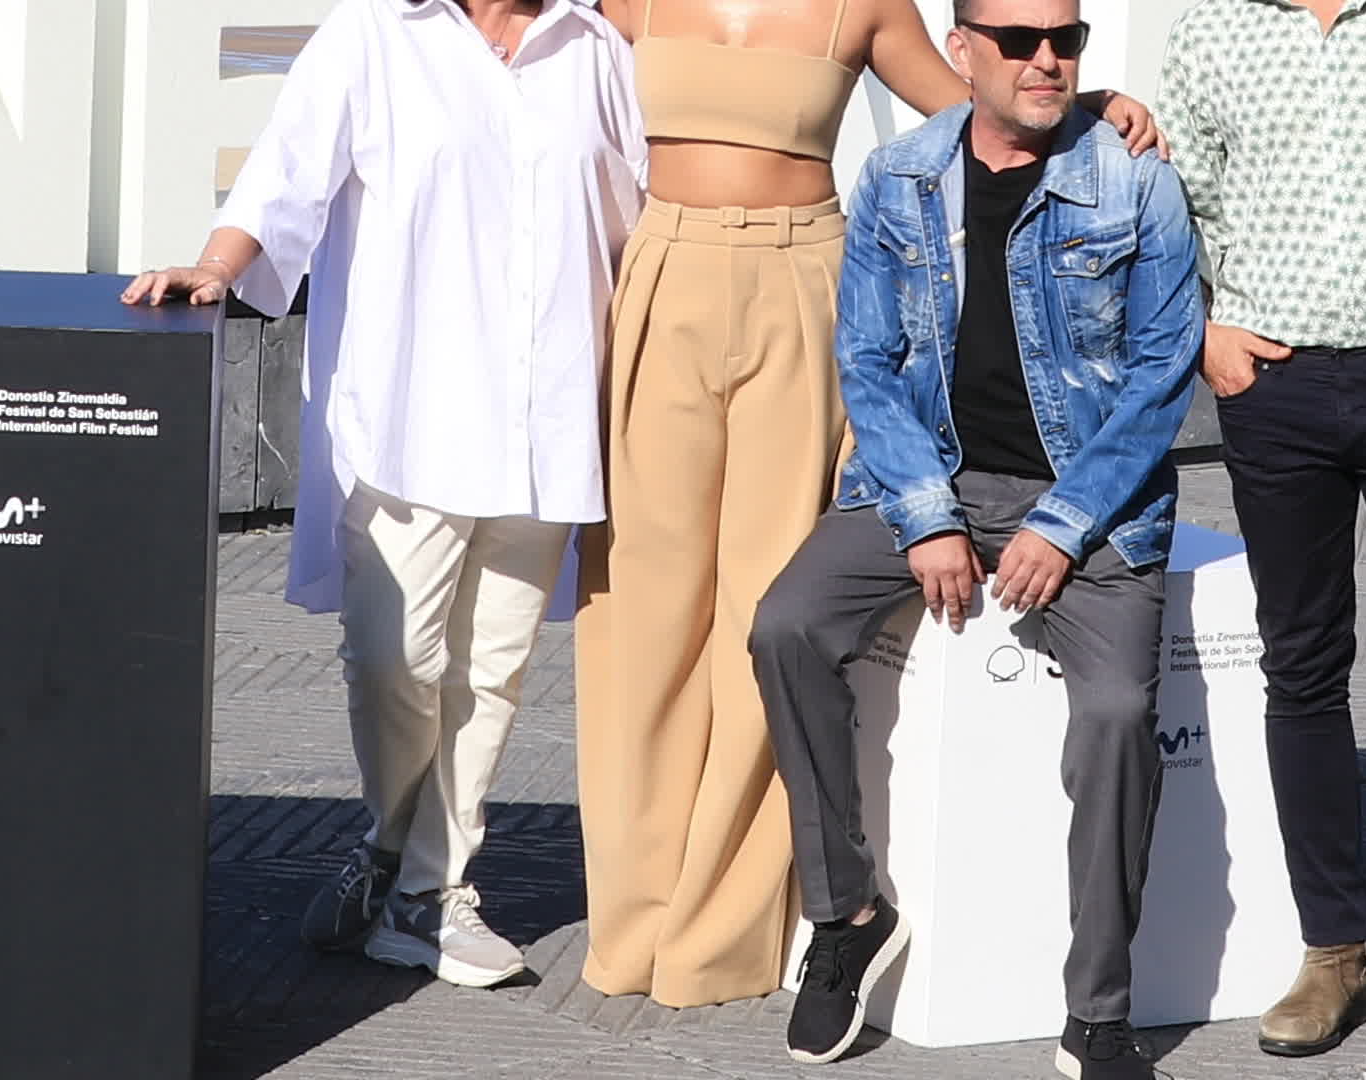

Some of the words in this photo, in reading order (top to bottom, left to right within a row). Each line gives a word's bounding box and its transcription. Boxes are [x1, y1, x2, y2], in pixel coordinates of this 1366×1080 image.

[57, 391, 127, 406] Zinemaldia
[48, 407, 65, 419] de
[68, 407, 93, 420] San
[95, 408, 159, 422] Sebastián
[79, 422, 107, 435] Film
[109, 424, 158, 437] Festival
[1171, 633, 1214, 645] Donostia
[1171, 648, 1207, 658] Festival
[1210, 647, 1222, 655] de
[1224, 646, 1242, 655] San
[1170, 660, 1230, 672] International
[1232, 658, 1253, 668] Film
[1162, 758, 1203, 769] ovistar
